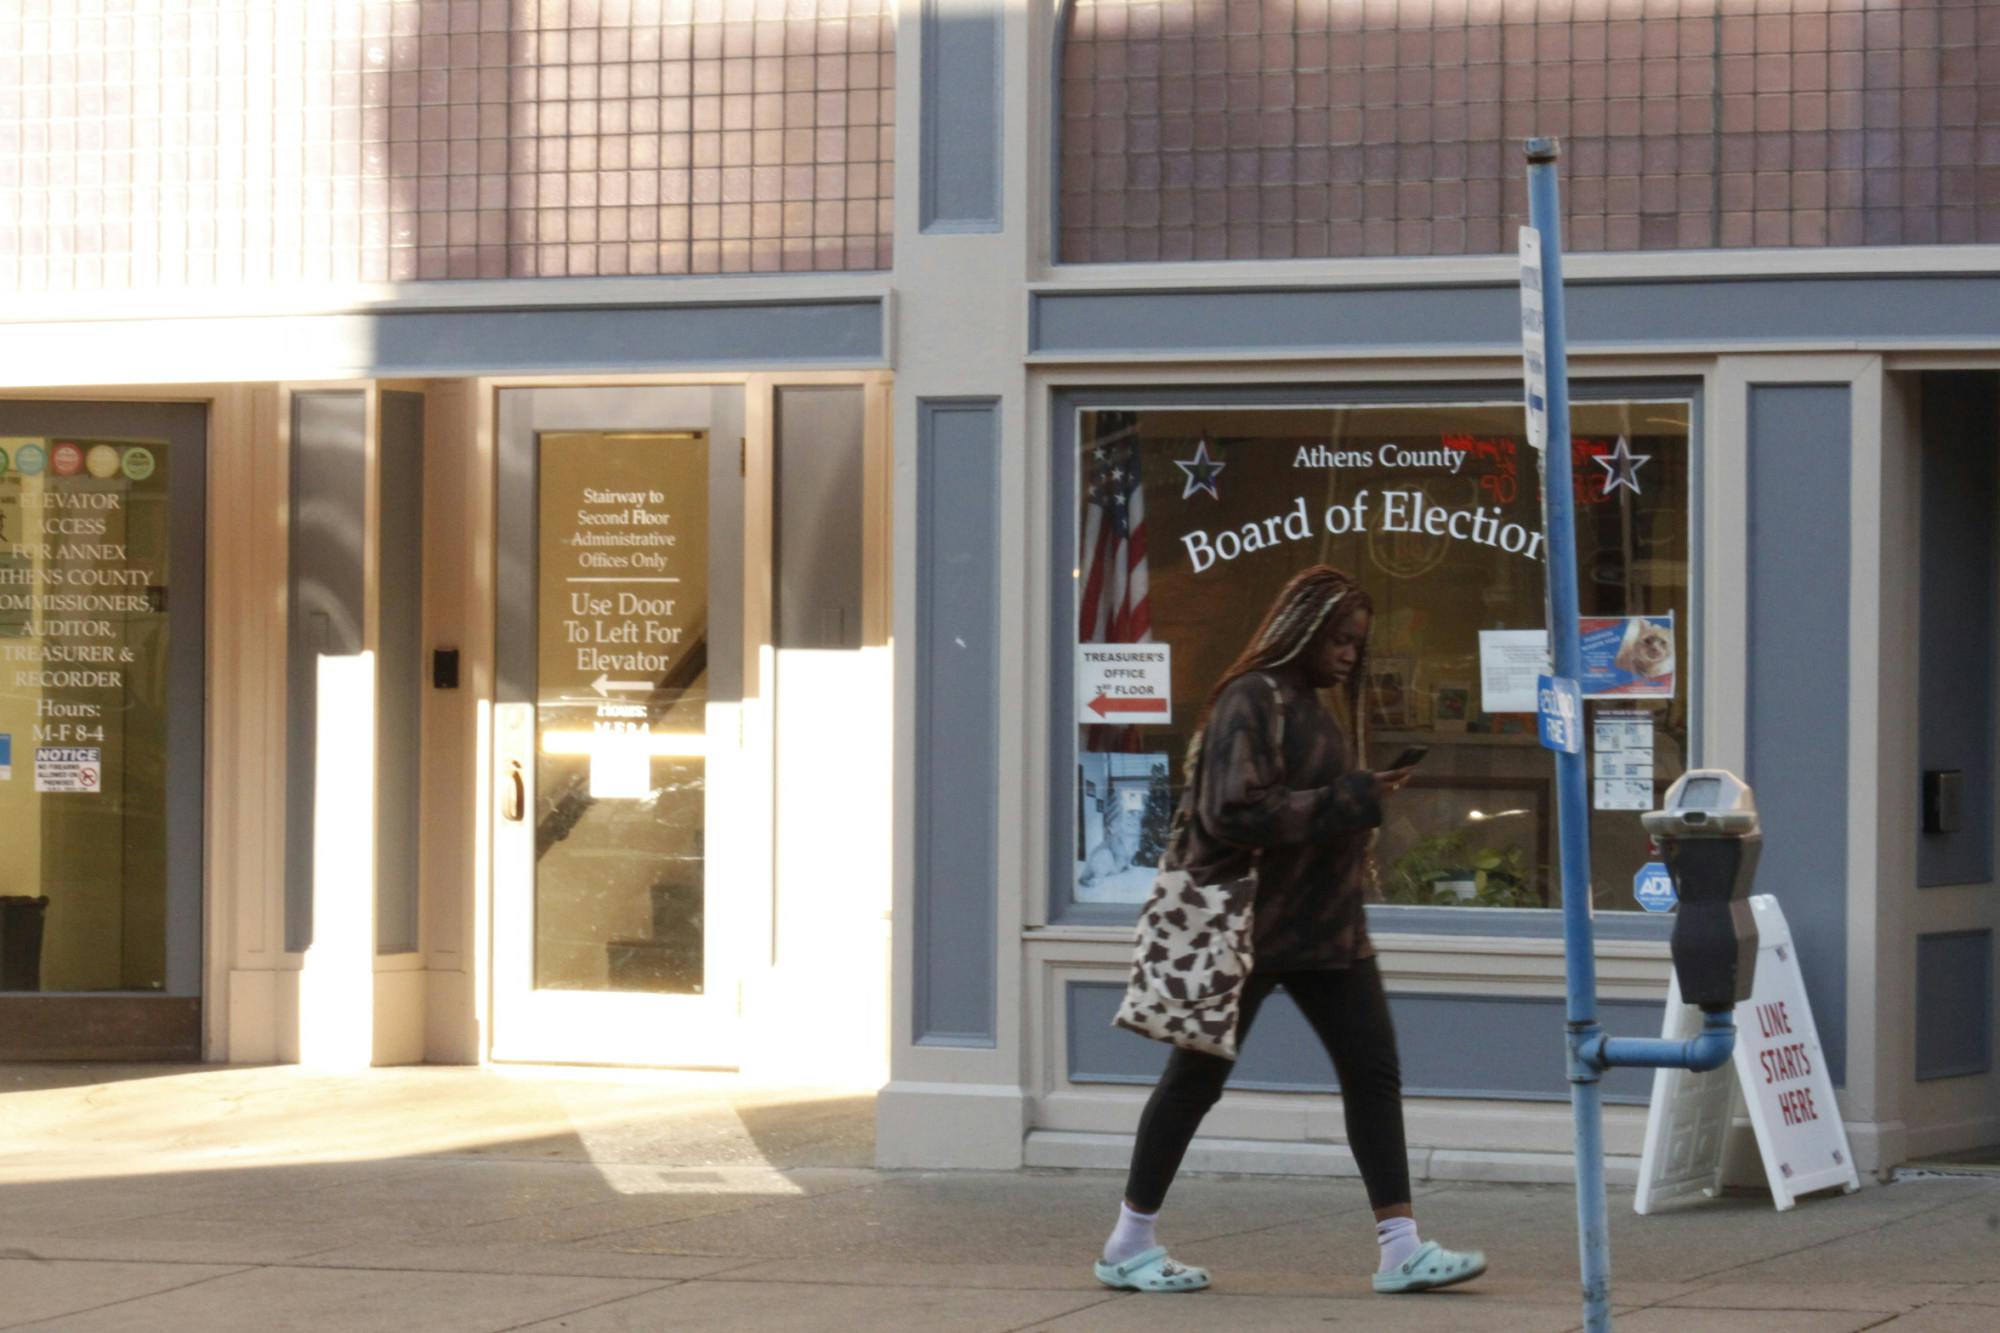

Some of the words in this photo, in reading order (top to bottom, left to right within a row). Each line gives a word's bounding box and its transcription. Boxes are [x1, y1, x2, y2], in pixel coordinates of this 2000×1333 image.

[1293, 445, 1373, 468] Athens
[1379, 444, 1466, 474] County
[20, 493, 120, 510] ELEVATOR
[583, 488, 646, 508] Stairway
[649, 490, 665, 503] to
[577, 510, 629, 526] Second
[632, 509, 670, 525] Floor
[571, 531, 676, 547] Administrative
[1180, 496, 1314, 574] Board
[1325, 489, 1369, 535] of
[1381, 490, 1546, 563] Election
[12, 544, 52, 560] FOR
[56, 544, 127, 560] ANNEX
[578, 552, 629, 568] Offices
[631, 552, 669, 572] Only
[0, 569, 63, 585] THENS
[67, 569, 154, 586] COUNTY
[0, 594, 155, 613] OMMISSIONERS,
[570, 592, 612, 616] Use
[618, 592, 676, 616] Door
[20, 621, 117, 637] AUDITOR,
[564, 620, 589, 643] To
[595, 620, 639, 643] Left
[644, 620, 682, 644] For
[4, 646, 115, 662] TREASURER
[119, 648, 135, 662] &
[577, 648, 669, 671] Elevator
[1084, 653, 1165, 662] TREASURER'S
[15, 671, 122, 687] RECORDER
[1104, 669, 1145, 679] OFFICE
[1115, 685, 1155, 695] FLOOR
[36, 700, 101, 717] Hours:
[32, 724, 71, 741] M-F
[75, 724, 105, 741] 8-4
[37, 749, 98, 761] NOTICE
[1639, 876, 1672, 896] ADT
[1756, 1001, 1792, 1038] LINE
[1760, 1042, 1812, 1084] STARTS
[1778, 1087, 1818, 1126] HERE
